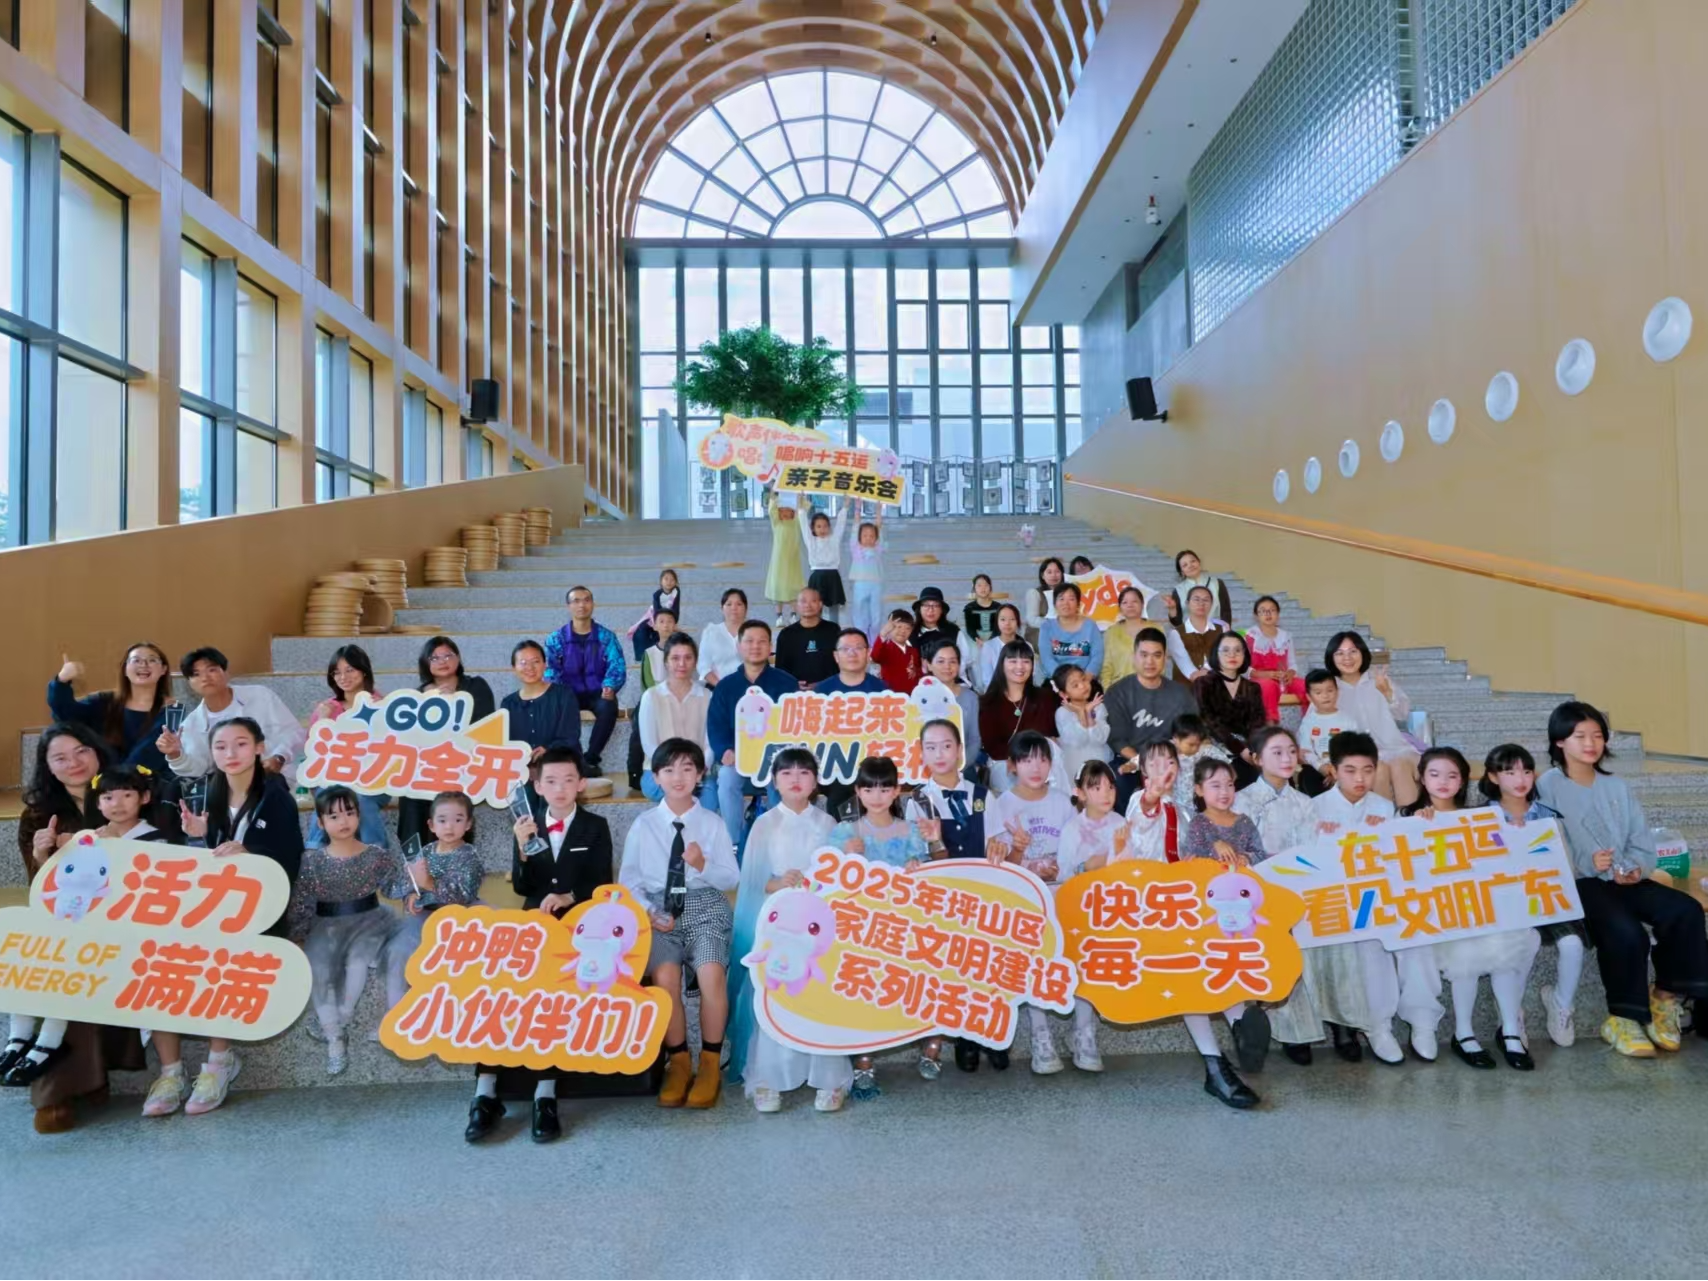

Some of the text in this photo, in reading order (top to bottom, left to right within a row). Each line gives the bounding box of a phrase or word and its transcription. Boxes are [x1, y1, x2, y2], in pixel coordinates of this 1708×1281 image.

[775, 444, 870, 470] 唱响十五运
[785, 466, 899, 500] 亲子音乐会
[385, 696, 466, 732] GO!
[780, 695, 907, 736] 嗨起来
[305, 727, 524, 800] 活力全开
[757, 741, 861, 782] FN
[1337, 812, 1509, 882] 在十五运
[106, 853, 263, 934] 活力
[814, 852, 1045, 948] 2025年坪山区
[1083, 882, 1200, 929] 快乐
[1303, 869, 1573, 940] 看见文明广东
[0, 932, 121, 967] FULL OF
[423, 920, 545, 978] 冲鸭
[830, 899, 1072, 1007] 家庭文明建设
[1080, 938, 1269, 992] 每一天
[115, 939, 283, 1025] 满满
[833, 952, 1011, 1043] 系列活动
[398, 985, 656, 1056] 小伙伴们!
